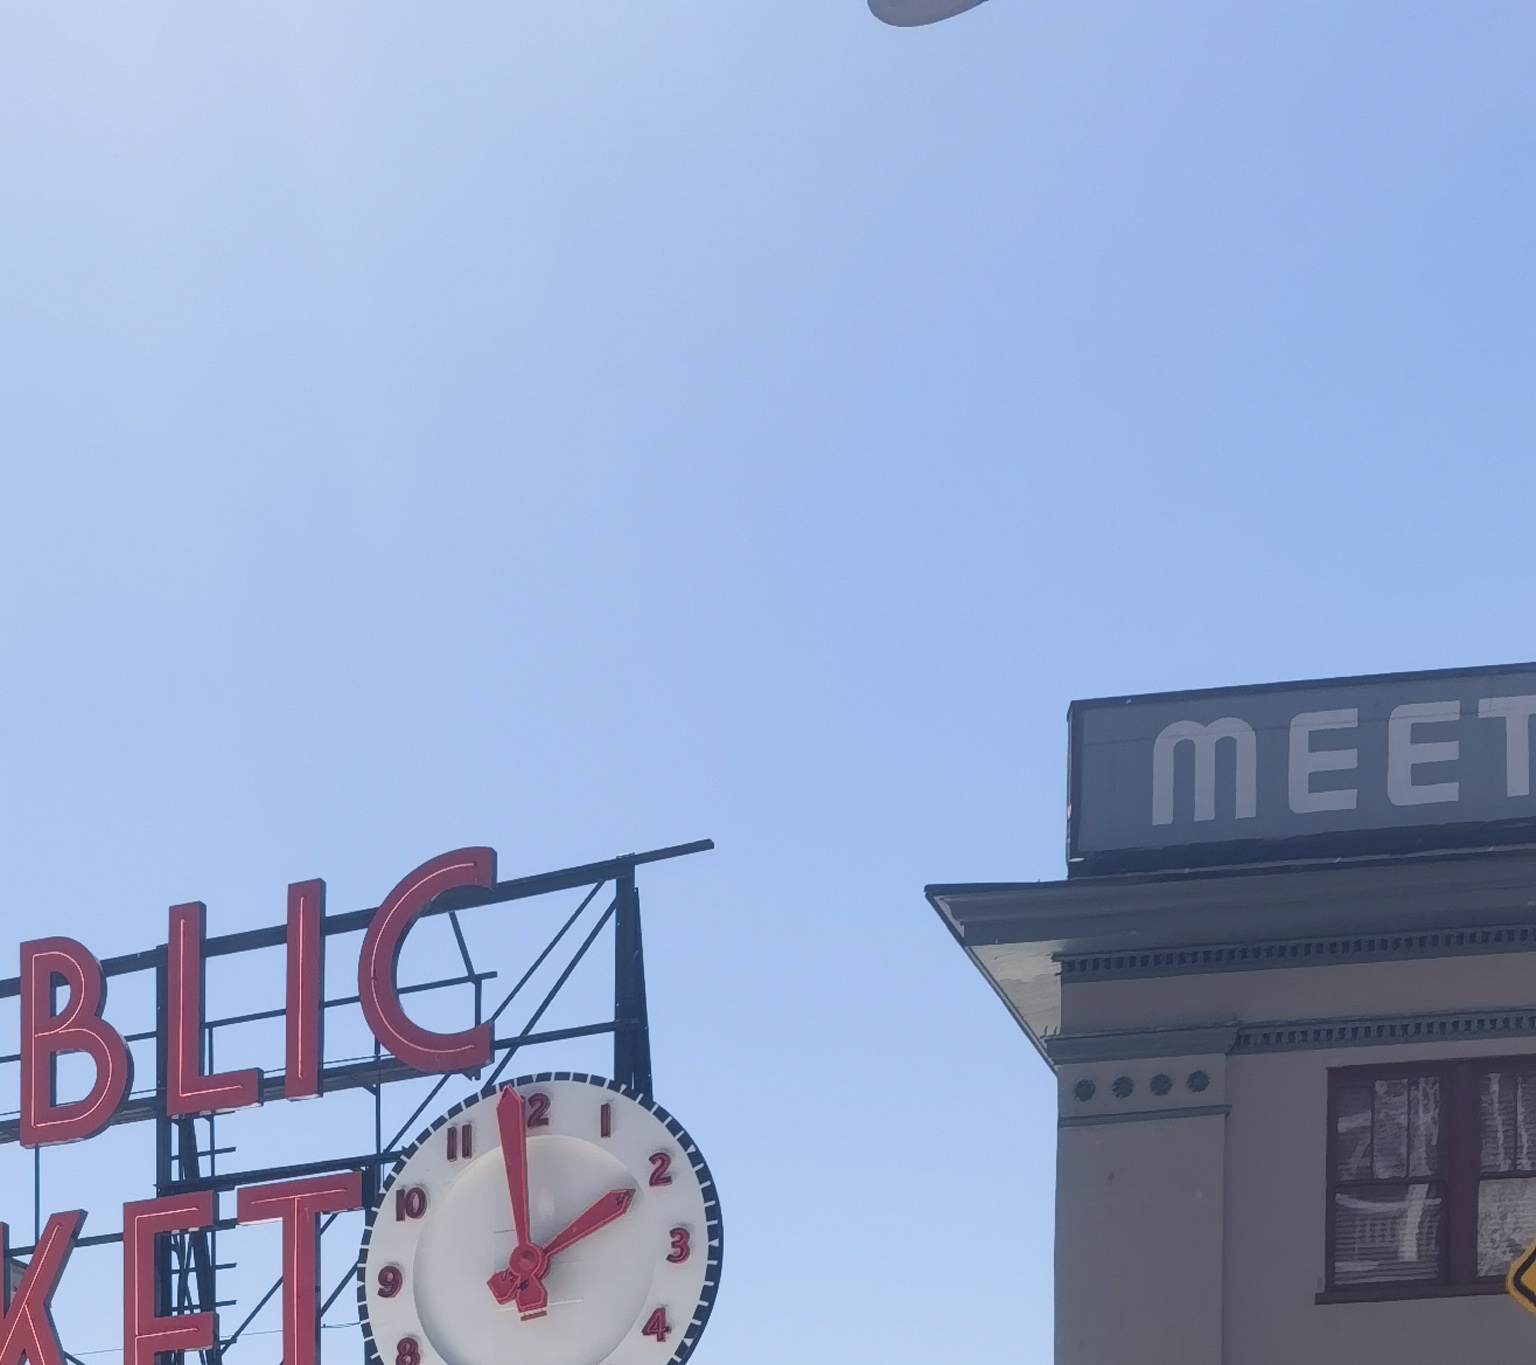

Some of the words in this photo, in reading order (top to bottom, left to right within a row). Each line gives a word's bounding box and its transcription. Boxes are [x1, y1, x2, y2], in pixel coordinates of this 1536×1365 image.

[1152, 695, 1536, 826] MEET
[600, 1102, 612, 1138] 1
[447, 1124, 473, 1161] 11
[649, 1152, 672, 1187] 2
[395, 1186, 428, 1222] 10
[666, 1227, 691, 1264] 3
[377, 1265, 403, 1299] 9
[641, 1307, 671, 1343] 4
